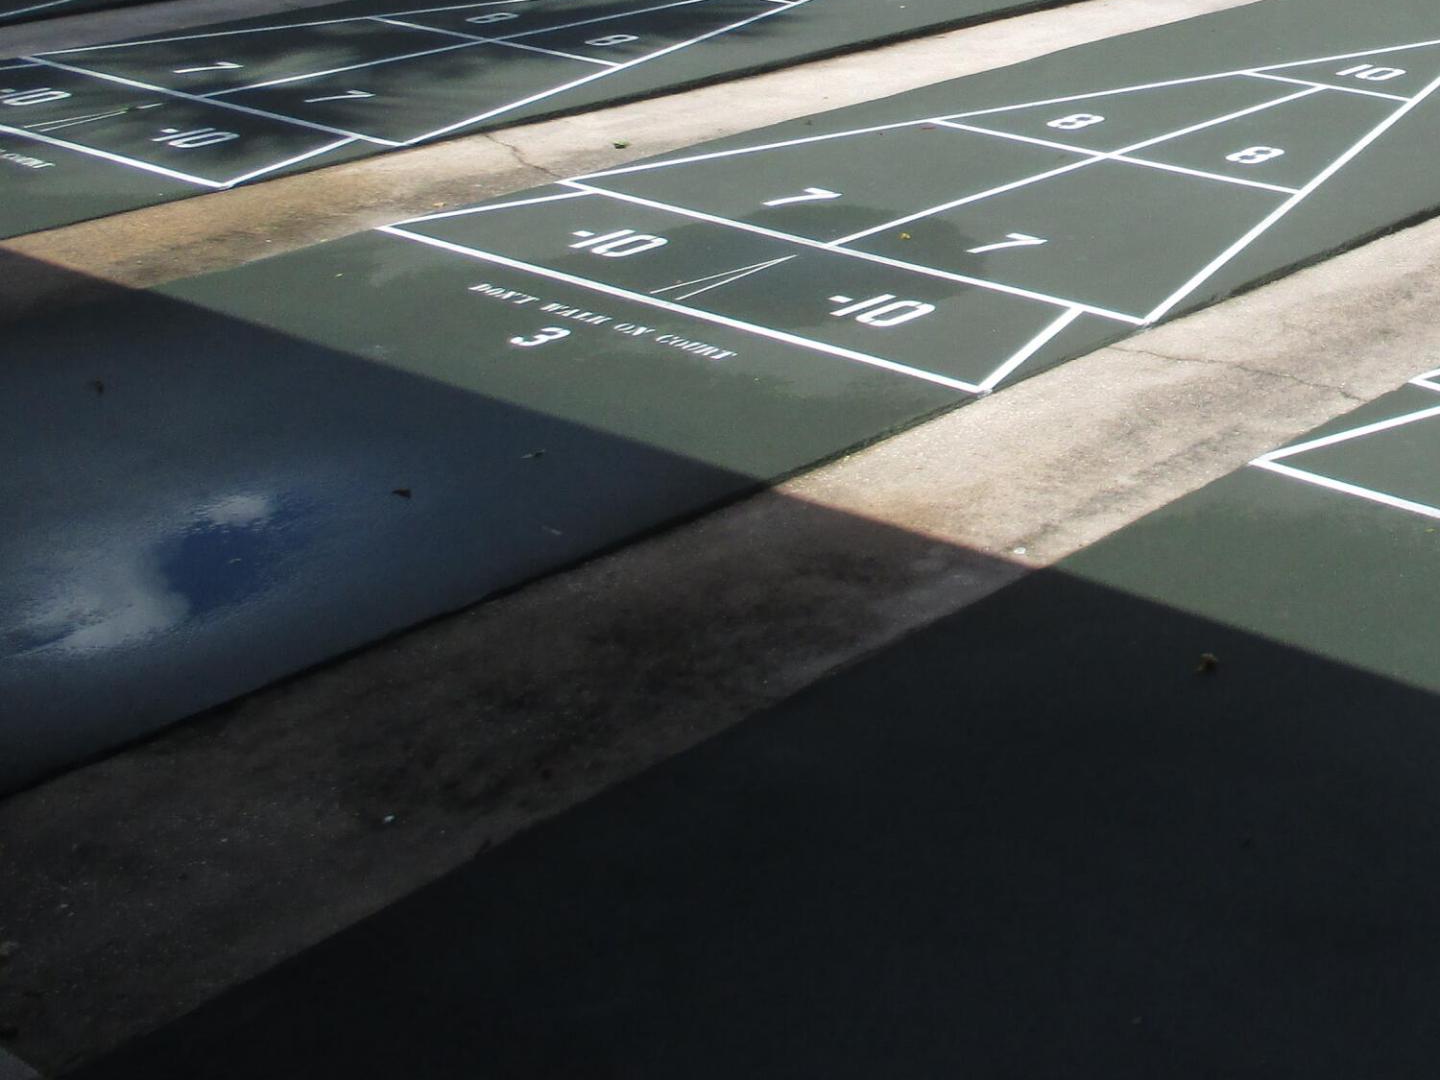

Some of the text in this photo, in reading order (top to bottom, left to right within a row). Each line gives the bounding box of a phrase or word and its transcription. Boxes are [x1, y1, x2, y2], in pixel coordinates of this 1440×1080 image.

[586, 35, 638, 45] 8
[174, 62, 243, 73] 7
[1336, 64, 1405, 80] 10
[306, 90, 374, 102] 7
[1047, 114, 1104, 129] 8
[152, 129, 237, 147] -10
[1226, 147, 1284, 163] 8
[763, 188, 842, 206] 7
[570, 230, 667, 257] -10
[967, 233, 1047, 253] 7
[830, 294, 935, 326] -10
[510, 327, 570, 346] 3
